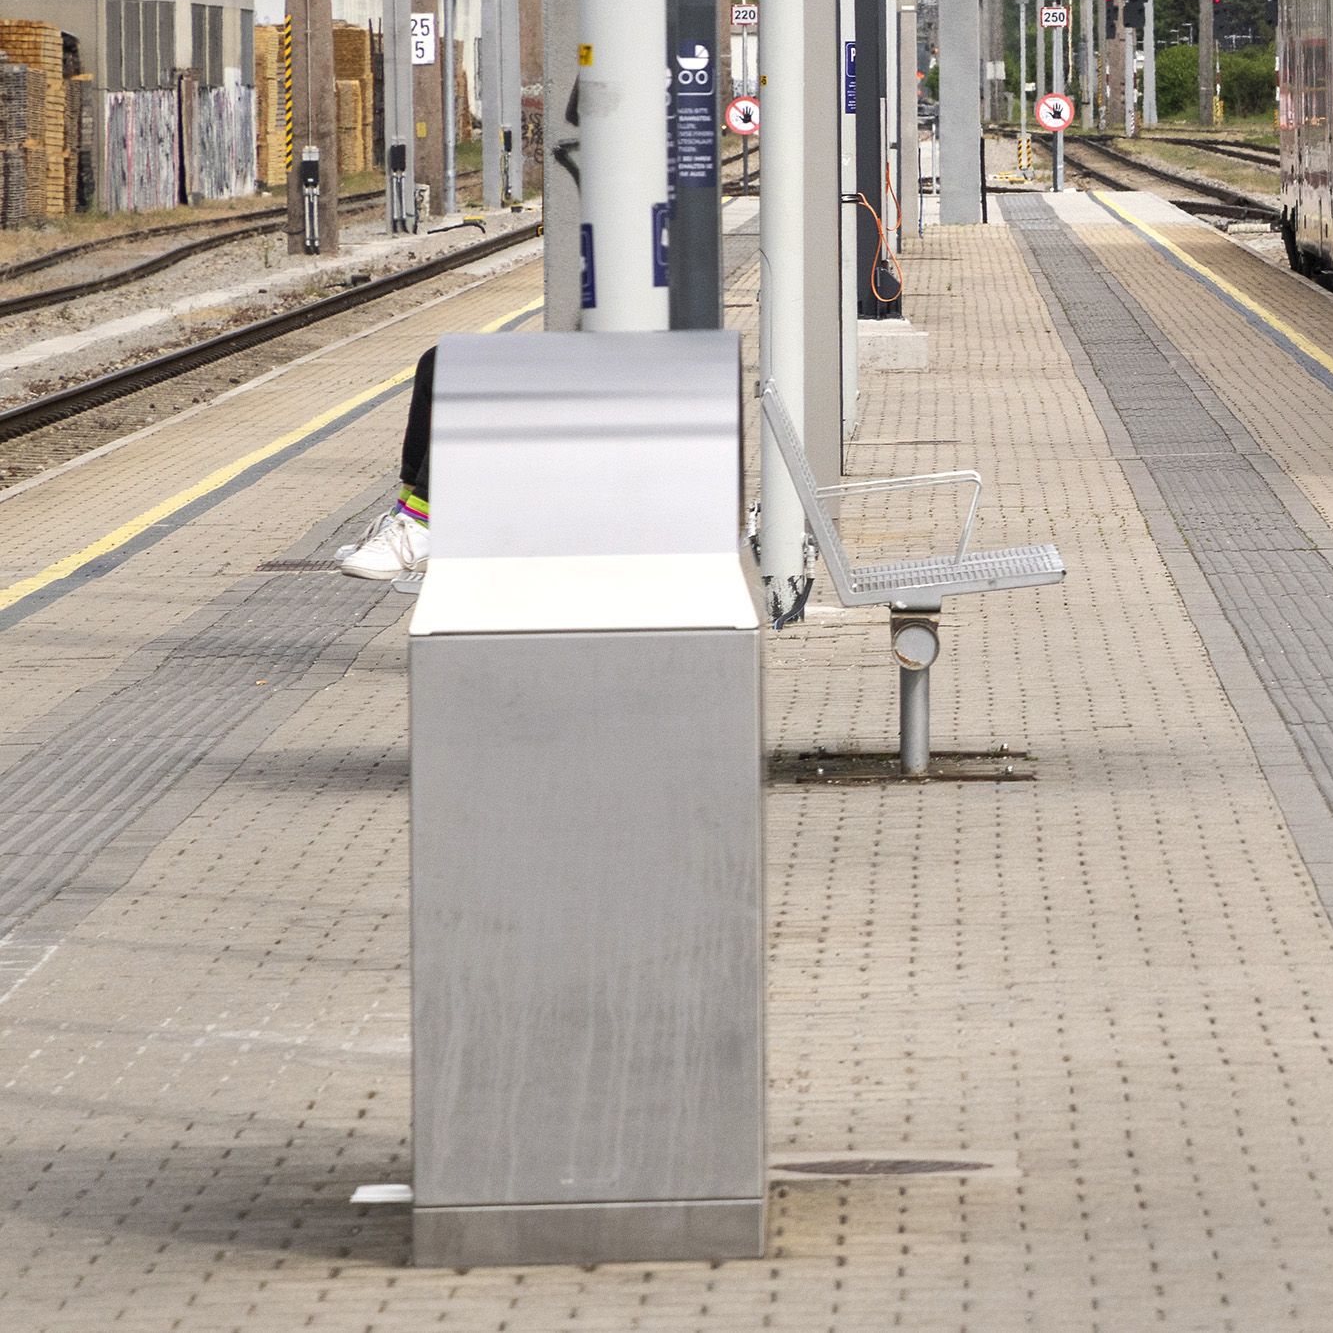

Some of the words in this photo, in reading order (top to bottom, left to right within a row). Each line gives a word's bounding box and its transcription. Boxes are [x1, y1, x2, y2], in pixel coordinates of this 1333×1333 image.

[734, 9, 756, 21] 220
[1043, 12, 1066, 23] 250
[414, 41, 425, 59] 5
